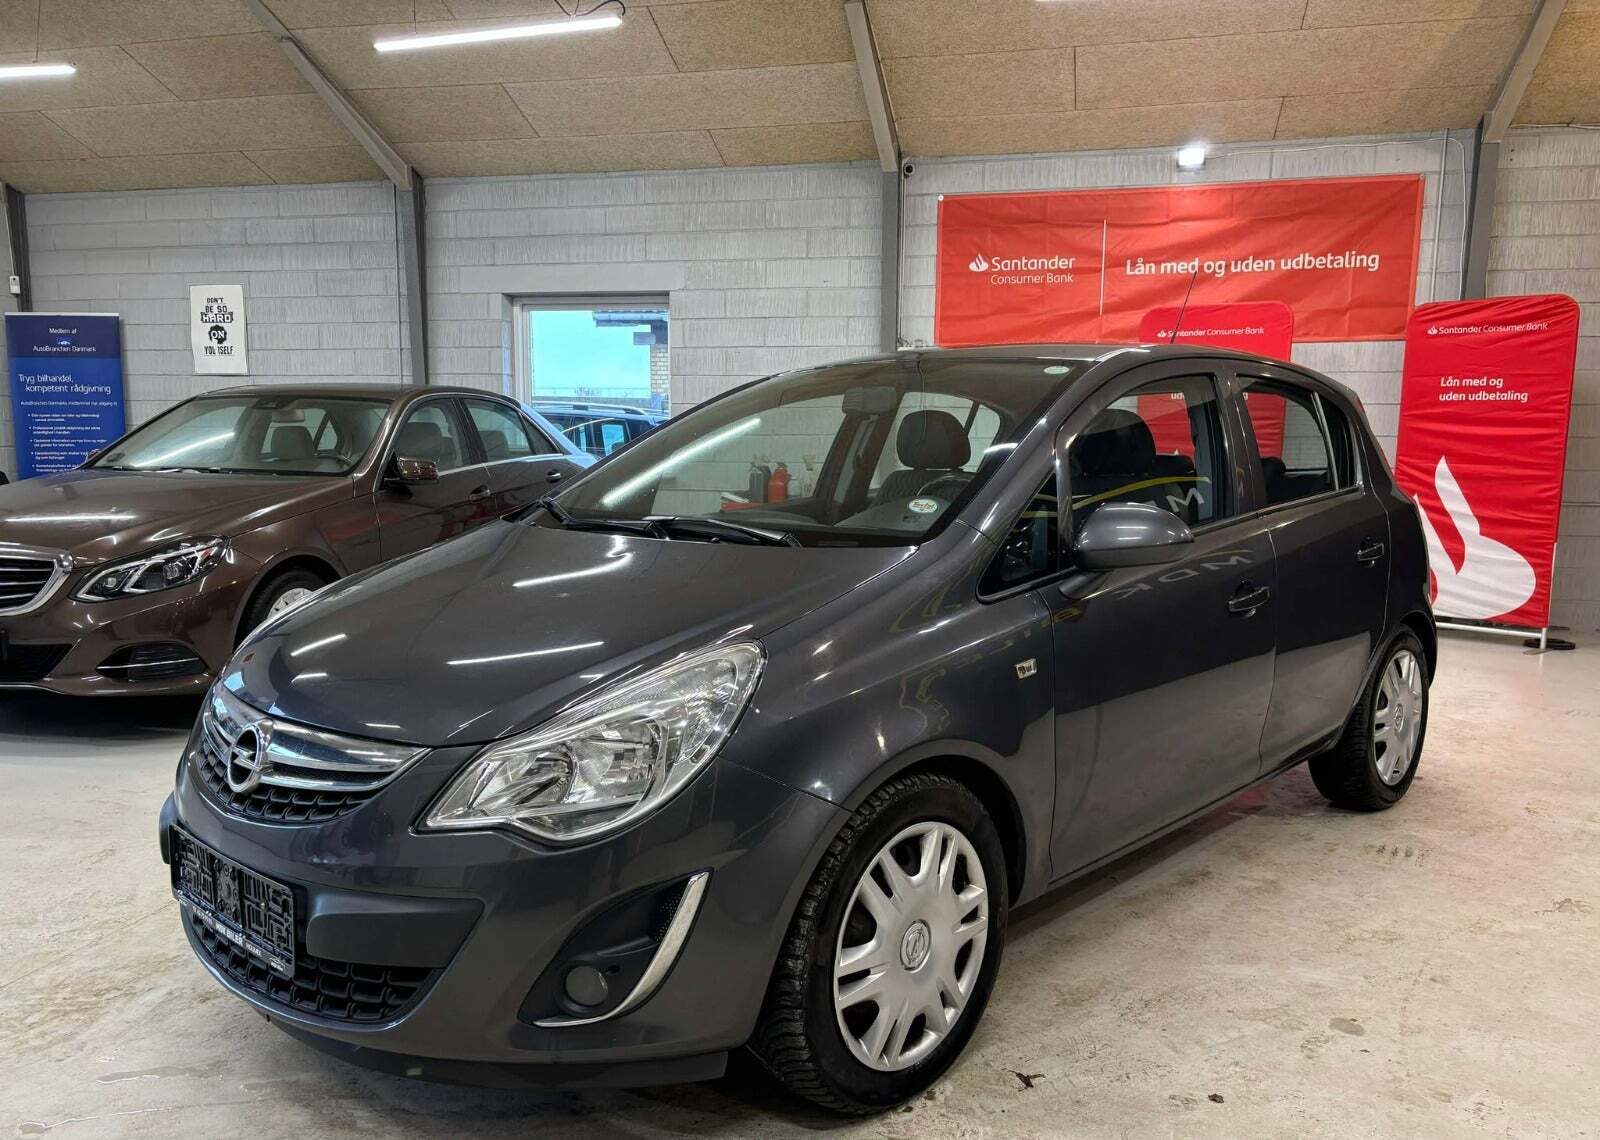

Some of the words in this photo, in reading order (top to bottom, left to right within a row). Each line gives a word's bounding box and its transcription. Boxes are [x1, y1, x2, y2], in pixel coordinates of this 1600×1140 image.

[991, 255, 1076, 271] Santander
[1125, 258, 1155, 275] Lån
[1160, 258, 1200, 274] med
[1203, 259, 1225, 277] og
[1230, 256, 1275, 273] uden
[1280, 251, 1380, 271] udbetaling
[991, 274, 1045, 285] Consumer
[1046, 272, 1074, 283] Bank
[202, 314, 231, 323] HARD
[210, 330, 225, 339] ON
[1168, 329, 1206, 337] Sntander
[1207, 328, 1244, 336] Consumer
[1245, 327, 1265, 335] Bank
[1439, 325, 1481, 335] Santander
[1483, 323, 1525, 333] Consumer
[1526, 322, 1548, 331] Bank
[17, 374, 34, 384] Tryg
[37, 374, 73, 383] bilhandel,
[1440, 376, 1460, 387] Lån
[1462, 376, 1487, 387] med
[1489, 378, 1504, 388] og
[25, 384, 68, 394] kompetent
[70, 384, 111, 395] rådgivning
[1439, 392, 1466, 401] uden
[1468, 390, 1528, 403] udbetaling
